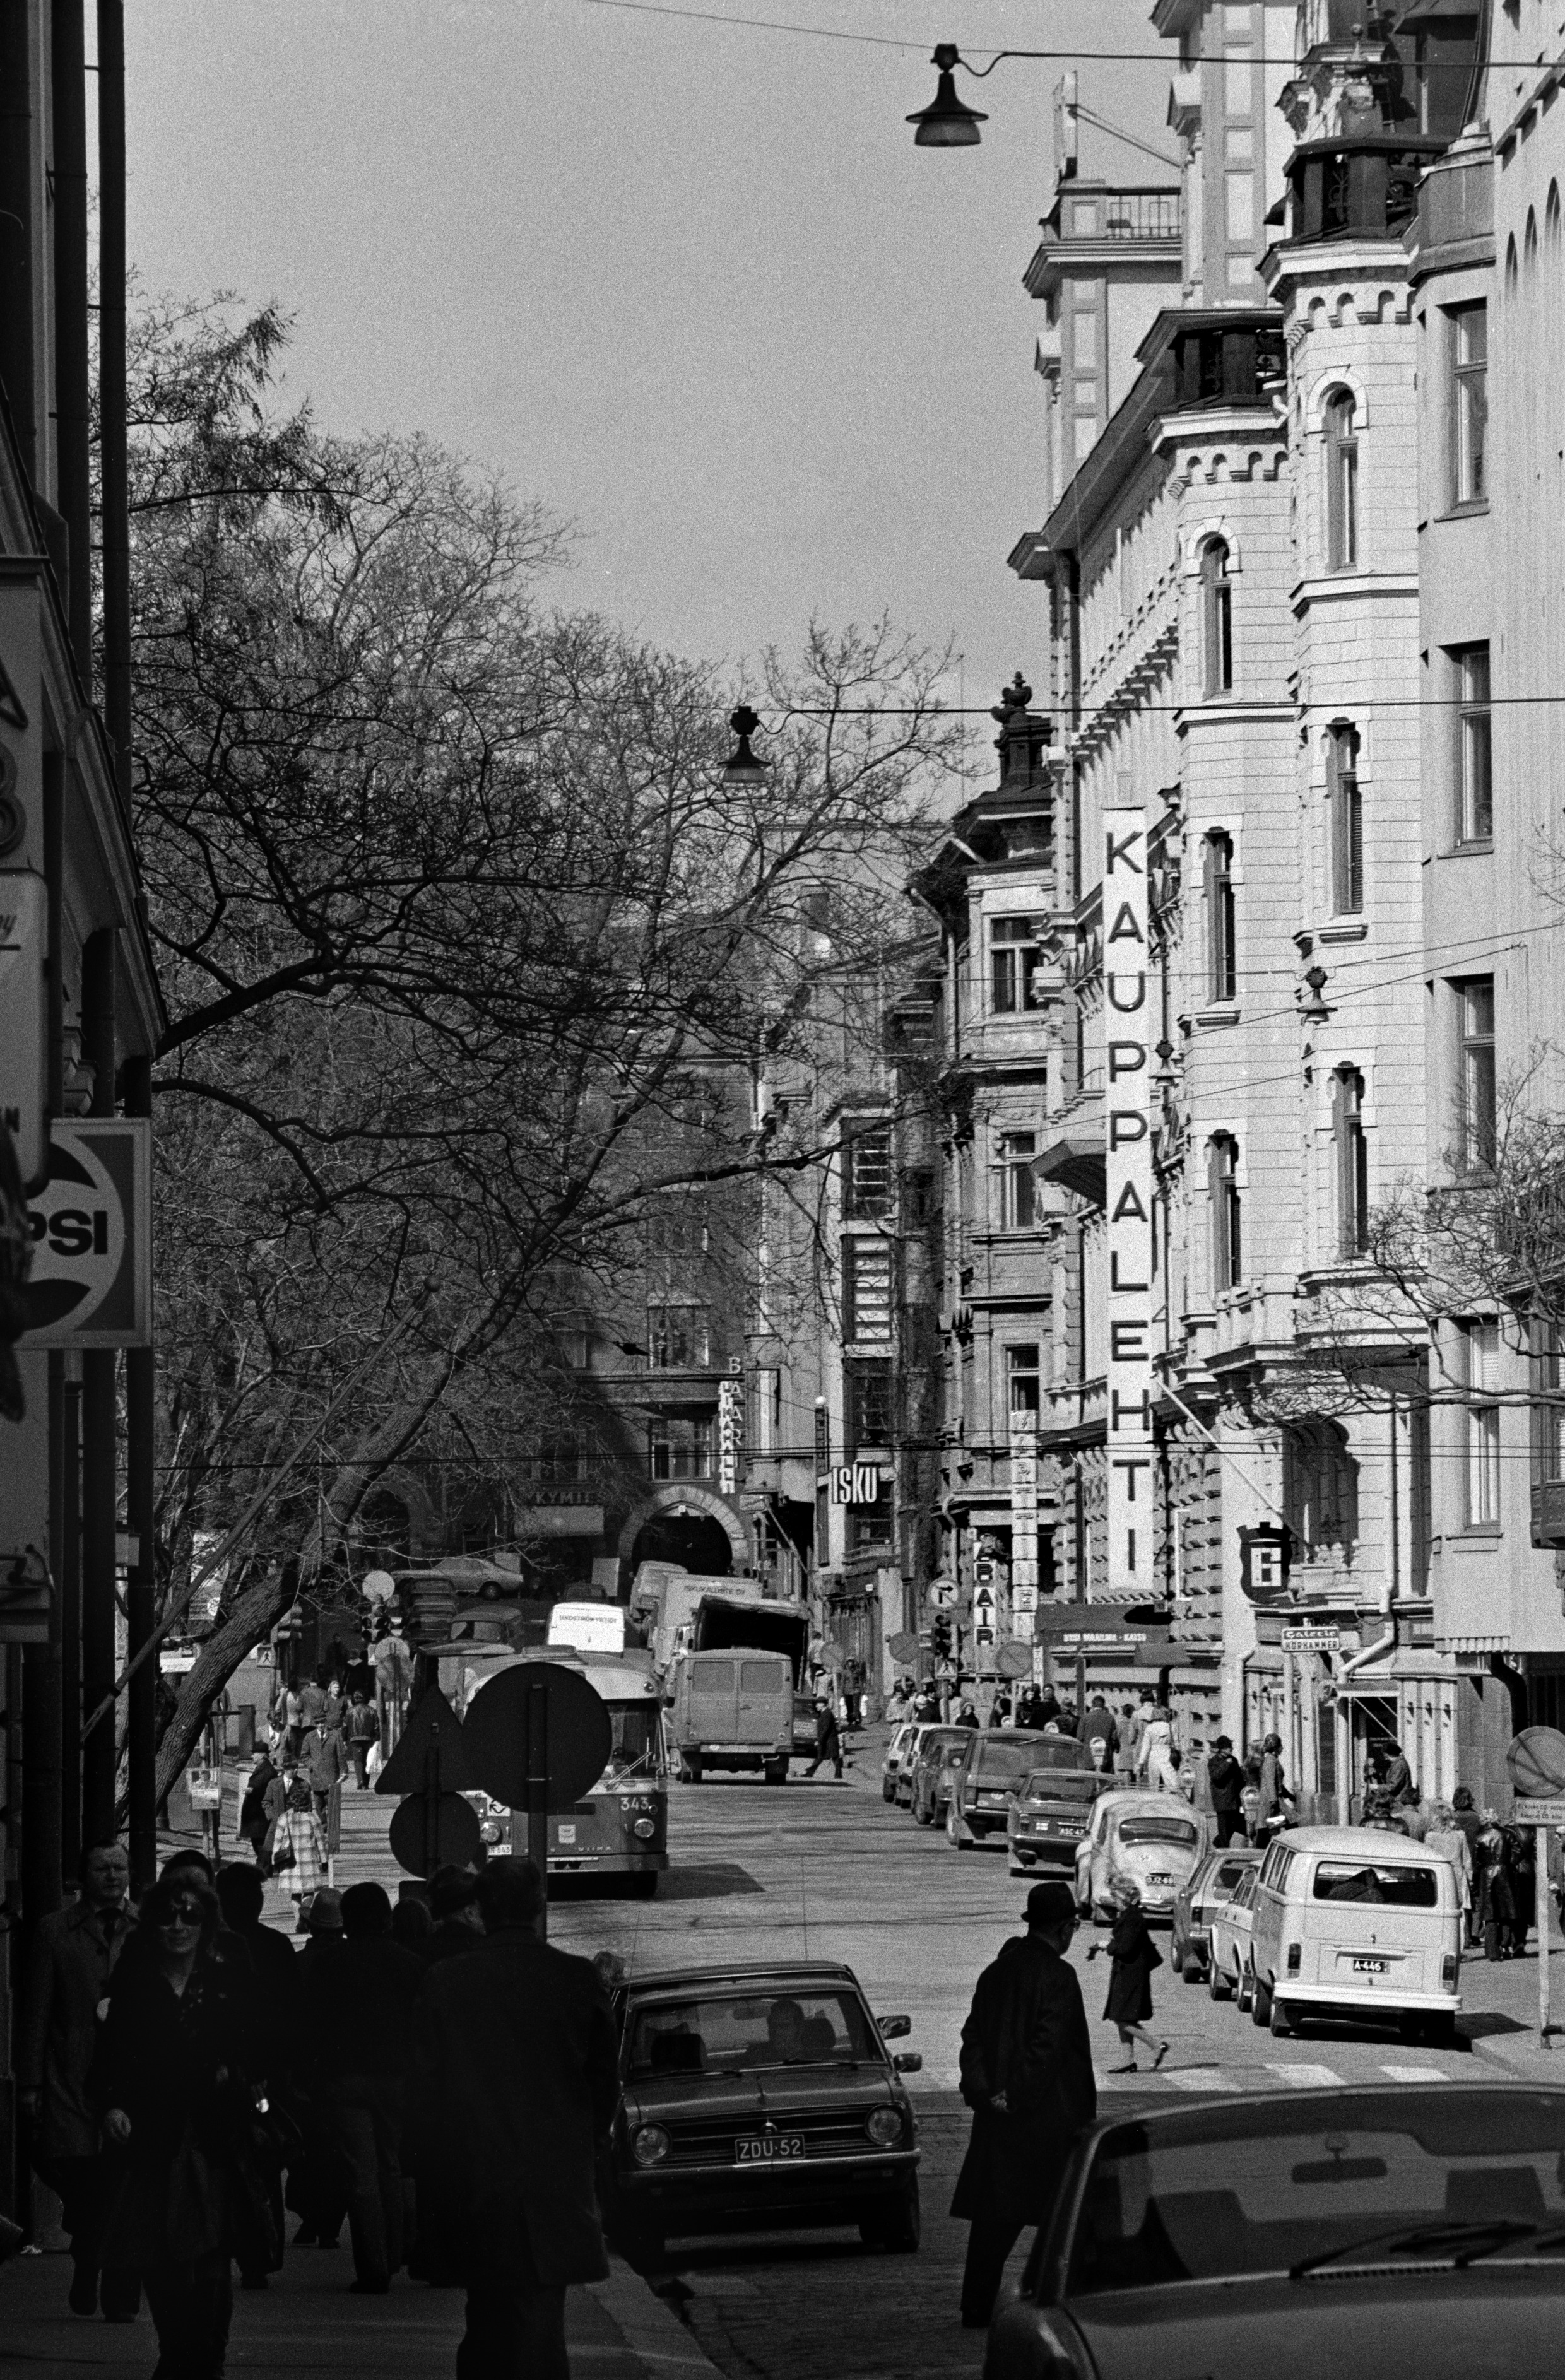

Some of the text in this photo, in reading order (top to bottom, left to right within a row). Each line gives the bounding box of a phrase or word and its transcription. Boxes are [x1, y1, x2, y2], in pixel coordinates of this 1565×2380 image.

[1106, 830, 1150, 1572] KAUPPALEHTI
[832, 1464, 877, 1504] ISKU
[620, 1797, 649, 1811] 343
